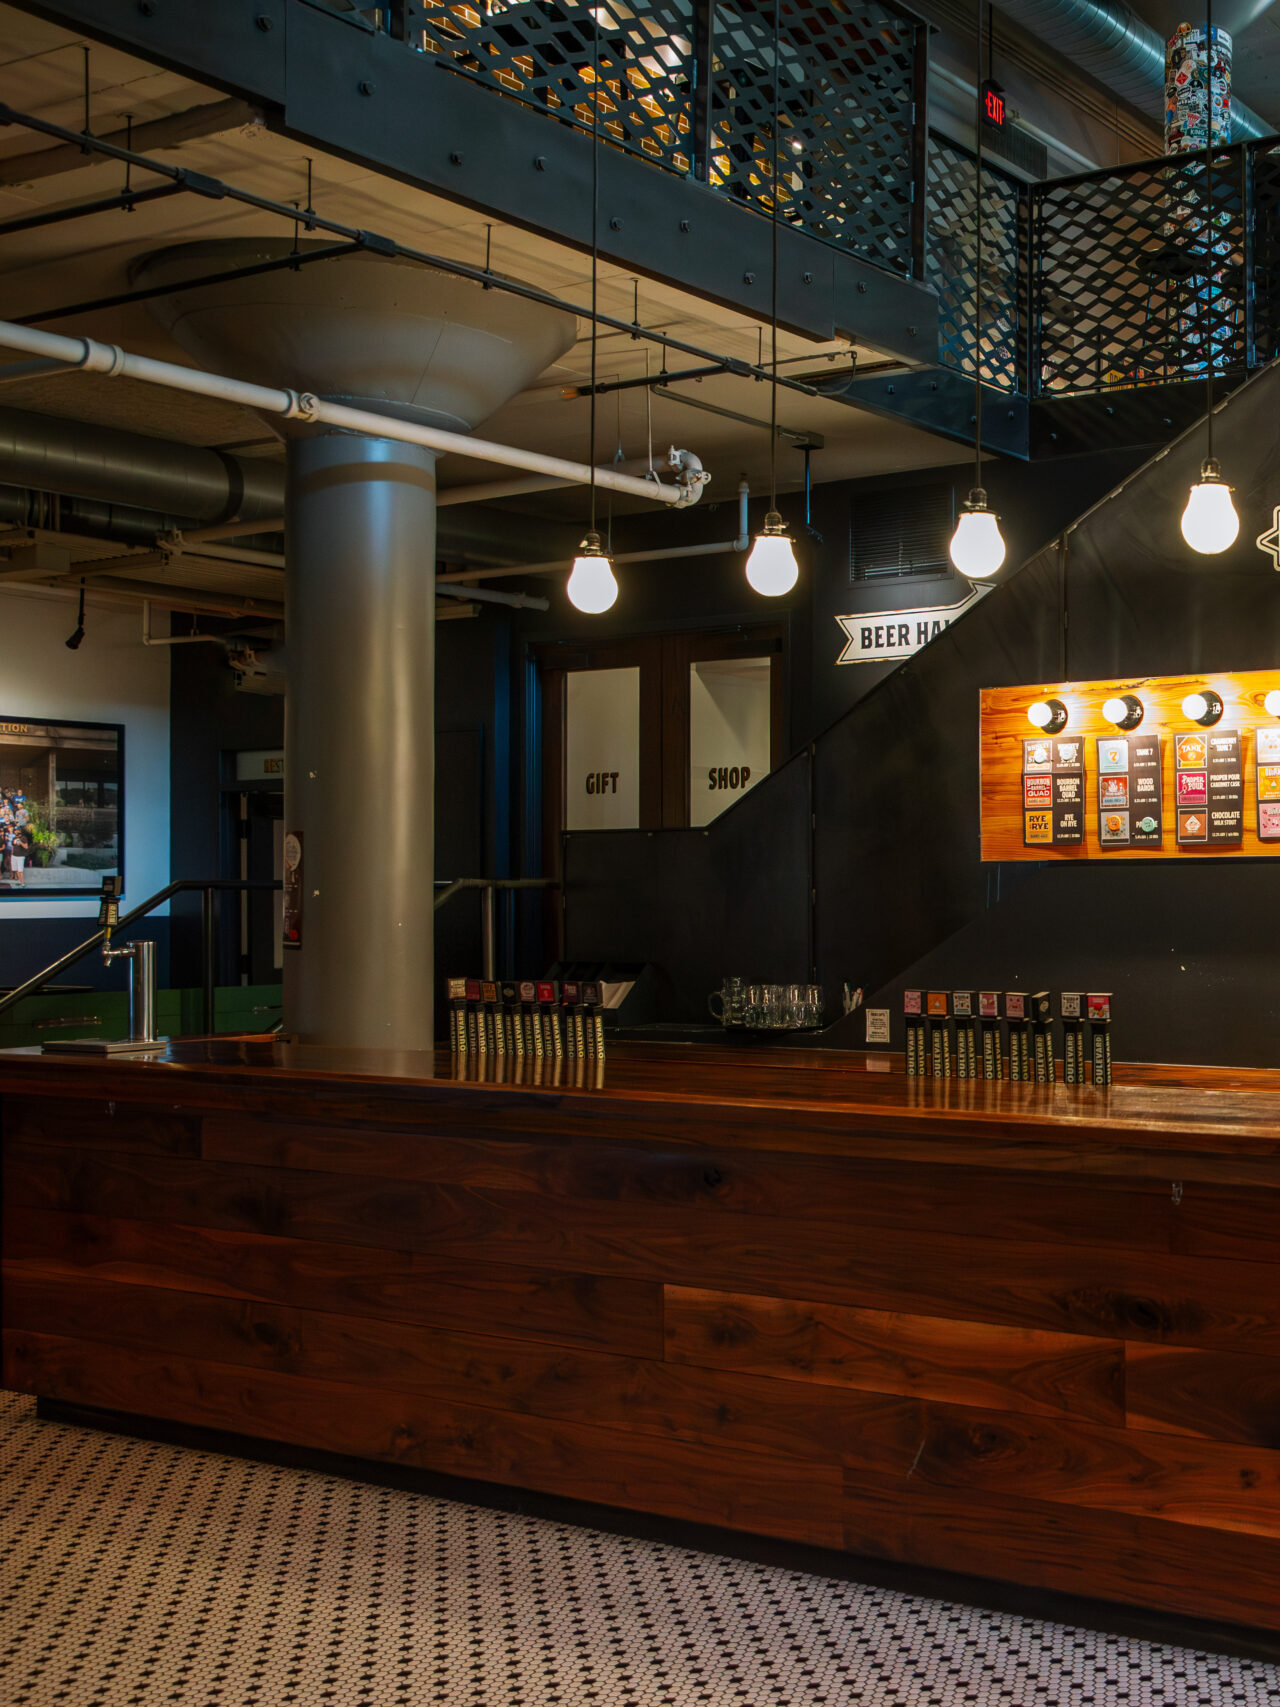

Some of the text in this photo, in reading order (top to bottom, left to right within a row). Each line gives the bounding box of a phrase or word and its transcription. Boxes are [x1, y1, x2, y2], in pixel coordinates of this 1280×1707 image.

[987, 90, 1003, 126] EXIT
[860, 620, 950, 649] BEER HA
[0, 722, 28, 733] TION
[1110, 752, 1117, 761] 7
[1149, 748, 1153, 756] 7
[1181, 744, 1202, 753] TANK
[586, 772, 619, 794] GIFT
[708, 766, 750, 790] SHOP
[1056, 778, 1080, 786] BOURBON
[1060, 784, 1077, 792] BARREL
[1137, 784, 1154, 792] BARON
[1182, 775, 1204, 784] PROPER
[1210, 774, 1227, 782] PROPER
[1062, 791, 1075, 799] QUAD
[1212, 811, 1240, 819] CHOCOLATE
[110, 904, 118, 925] BLVD
[458, 1011, 466, 1051] OULEVARD
[478, 1012, 486, 1053] OULEVARD
[496, 1013, 504, 1054] OULEVARD
[514, 1014, 523, 1055] OULEVARD
[533, 1014, 542, 1056] OULEVARD
[552, 1014, 561, 1056] OULEVARD
[576, 1015, 584, 1058] OULEVARD
[596, 1016, 604, 1058] OULEVARD
[933, 1031, 941, 1077] OULEVARD
[958, 1030, 966, 1078] OULEVARD
[1011, 1033, 1019, 1081] OULEVARD
[1036, 1036, 1045, 1083] OULEVARD
[1067, 1034, 1075, 1082] OULEVARD
[1096, 1035, 1104, 1084] OULEVARD
